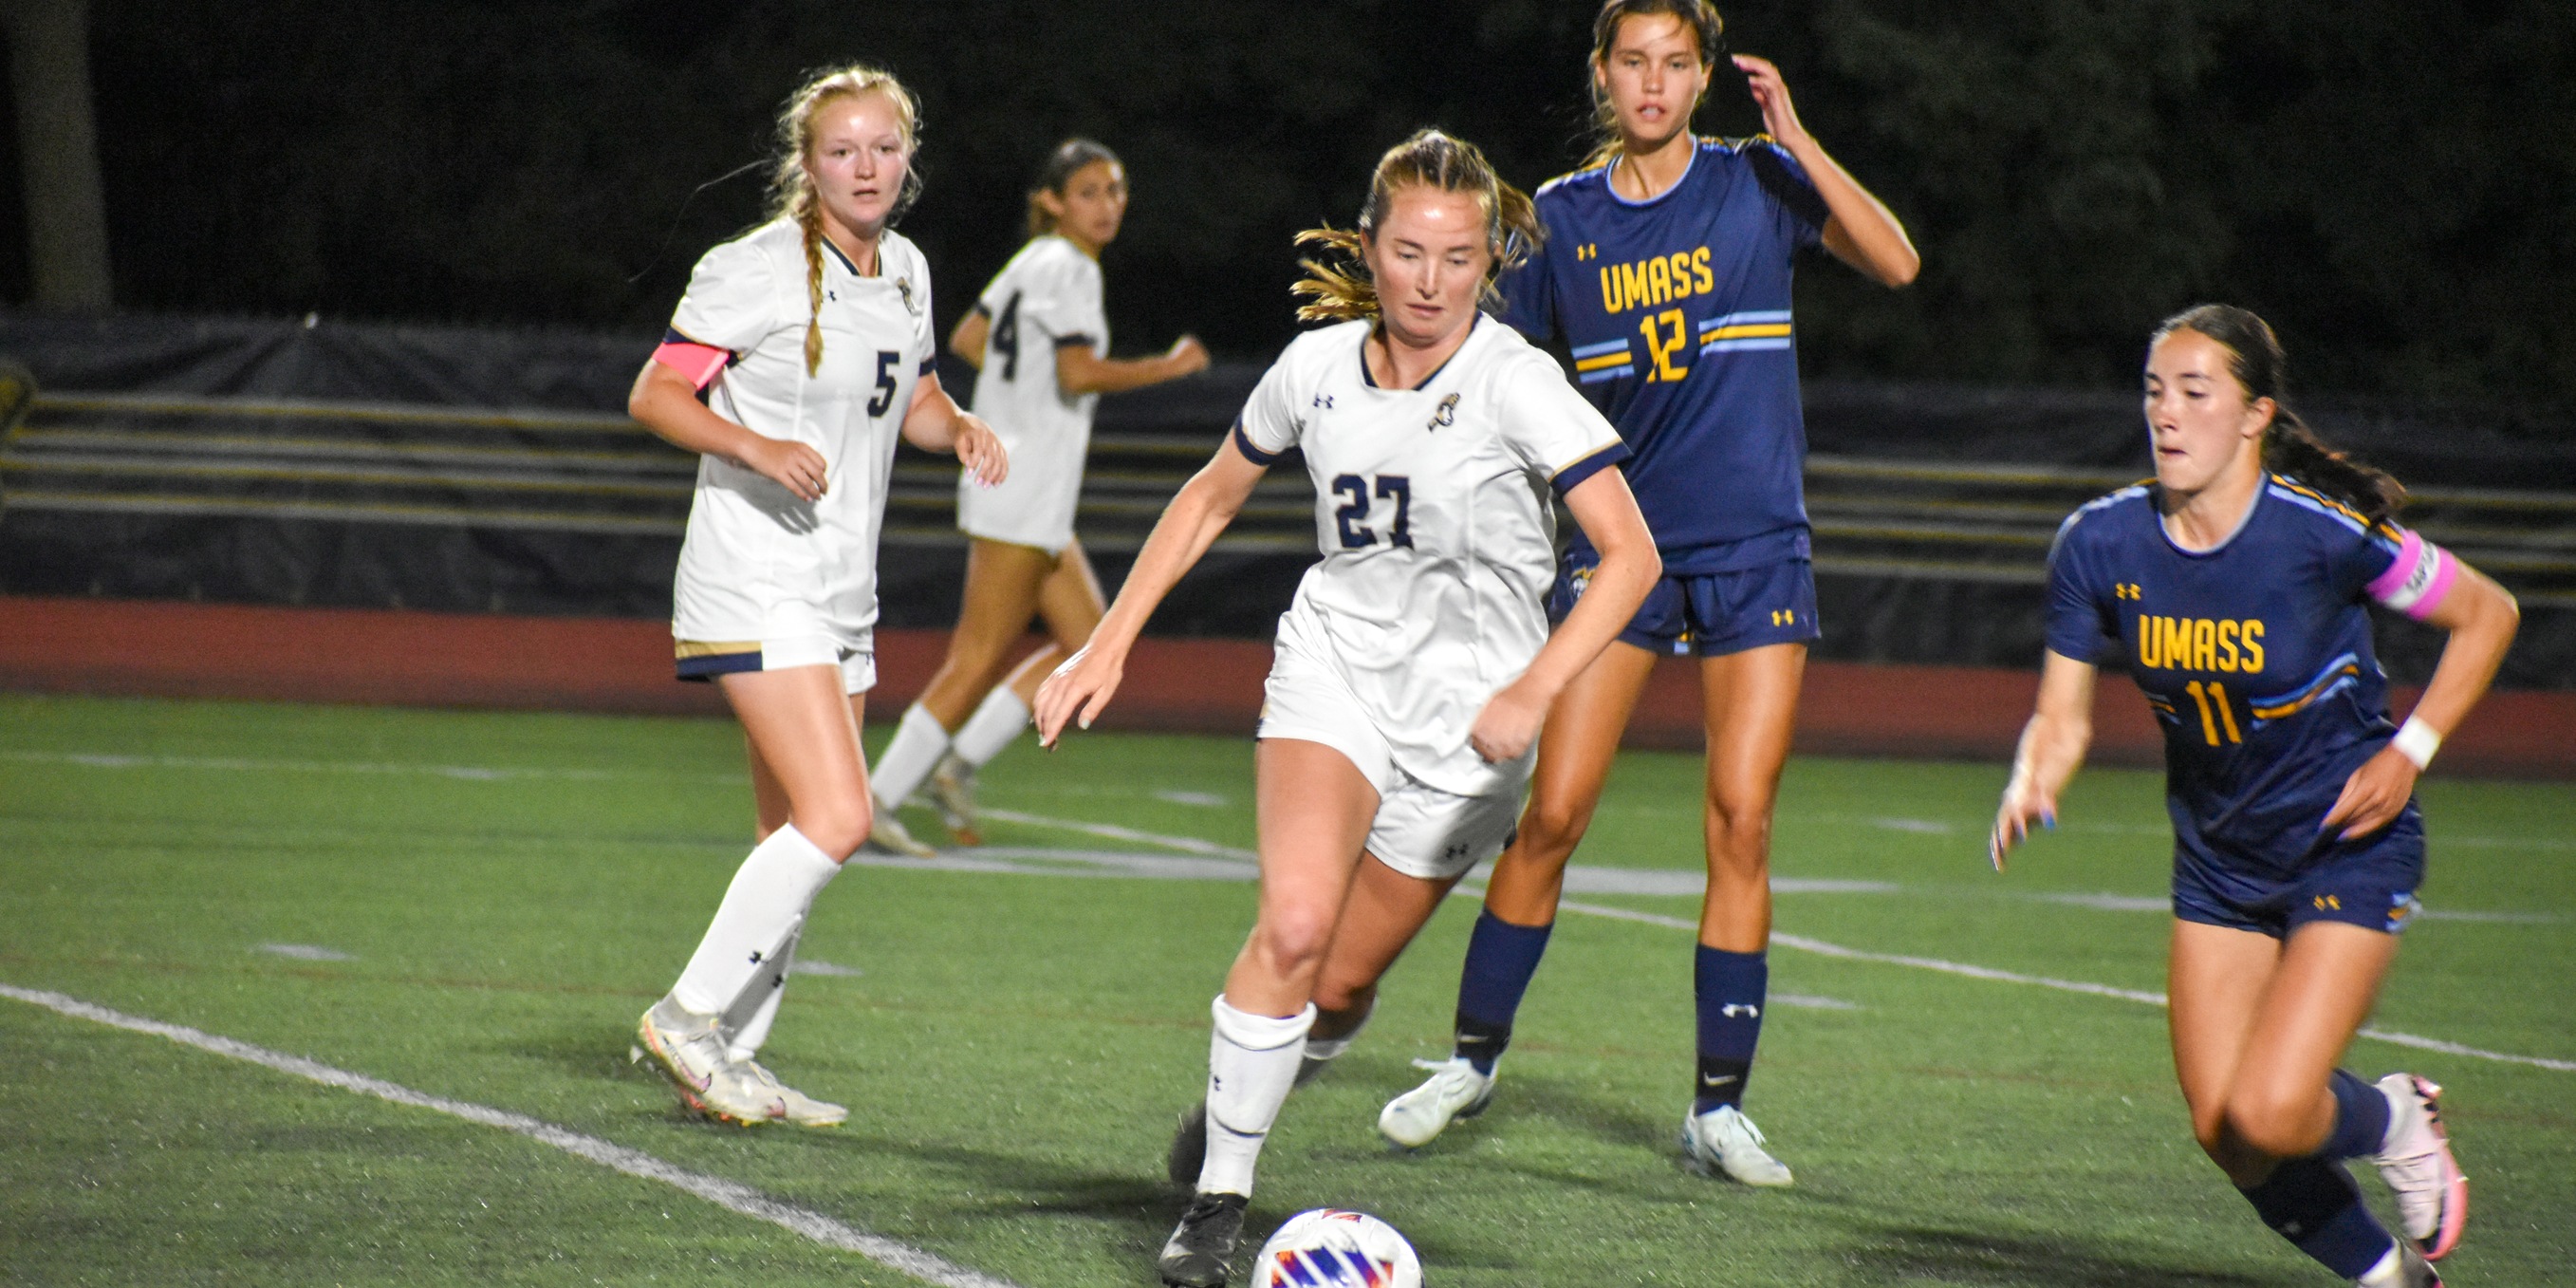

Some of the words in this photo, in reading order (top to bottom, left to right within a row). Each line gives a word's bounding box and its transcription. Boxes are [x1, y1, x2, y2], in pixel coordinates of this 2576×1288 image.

[1600, 246, 1714, 313] UMASS
[991, 289, 1020, 381] 4
[1640, 308, 1688, 383] 12
[867, 350, 900, 418] 5
[1331, 473, 1415, 551] 27
[2139, 614, 2265, 673] UMASS
[2185, 681, 2242, 746] 11
